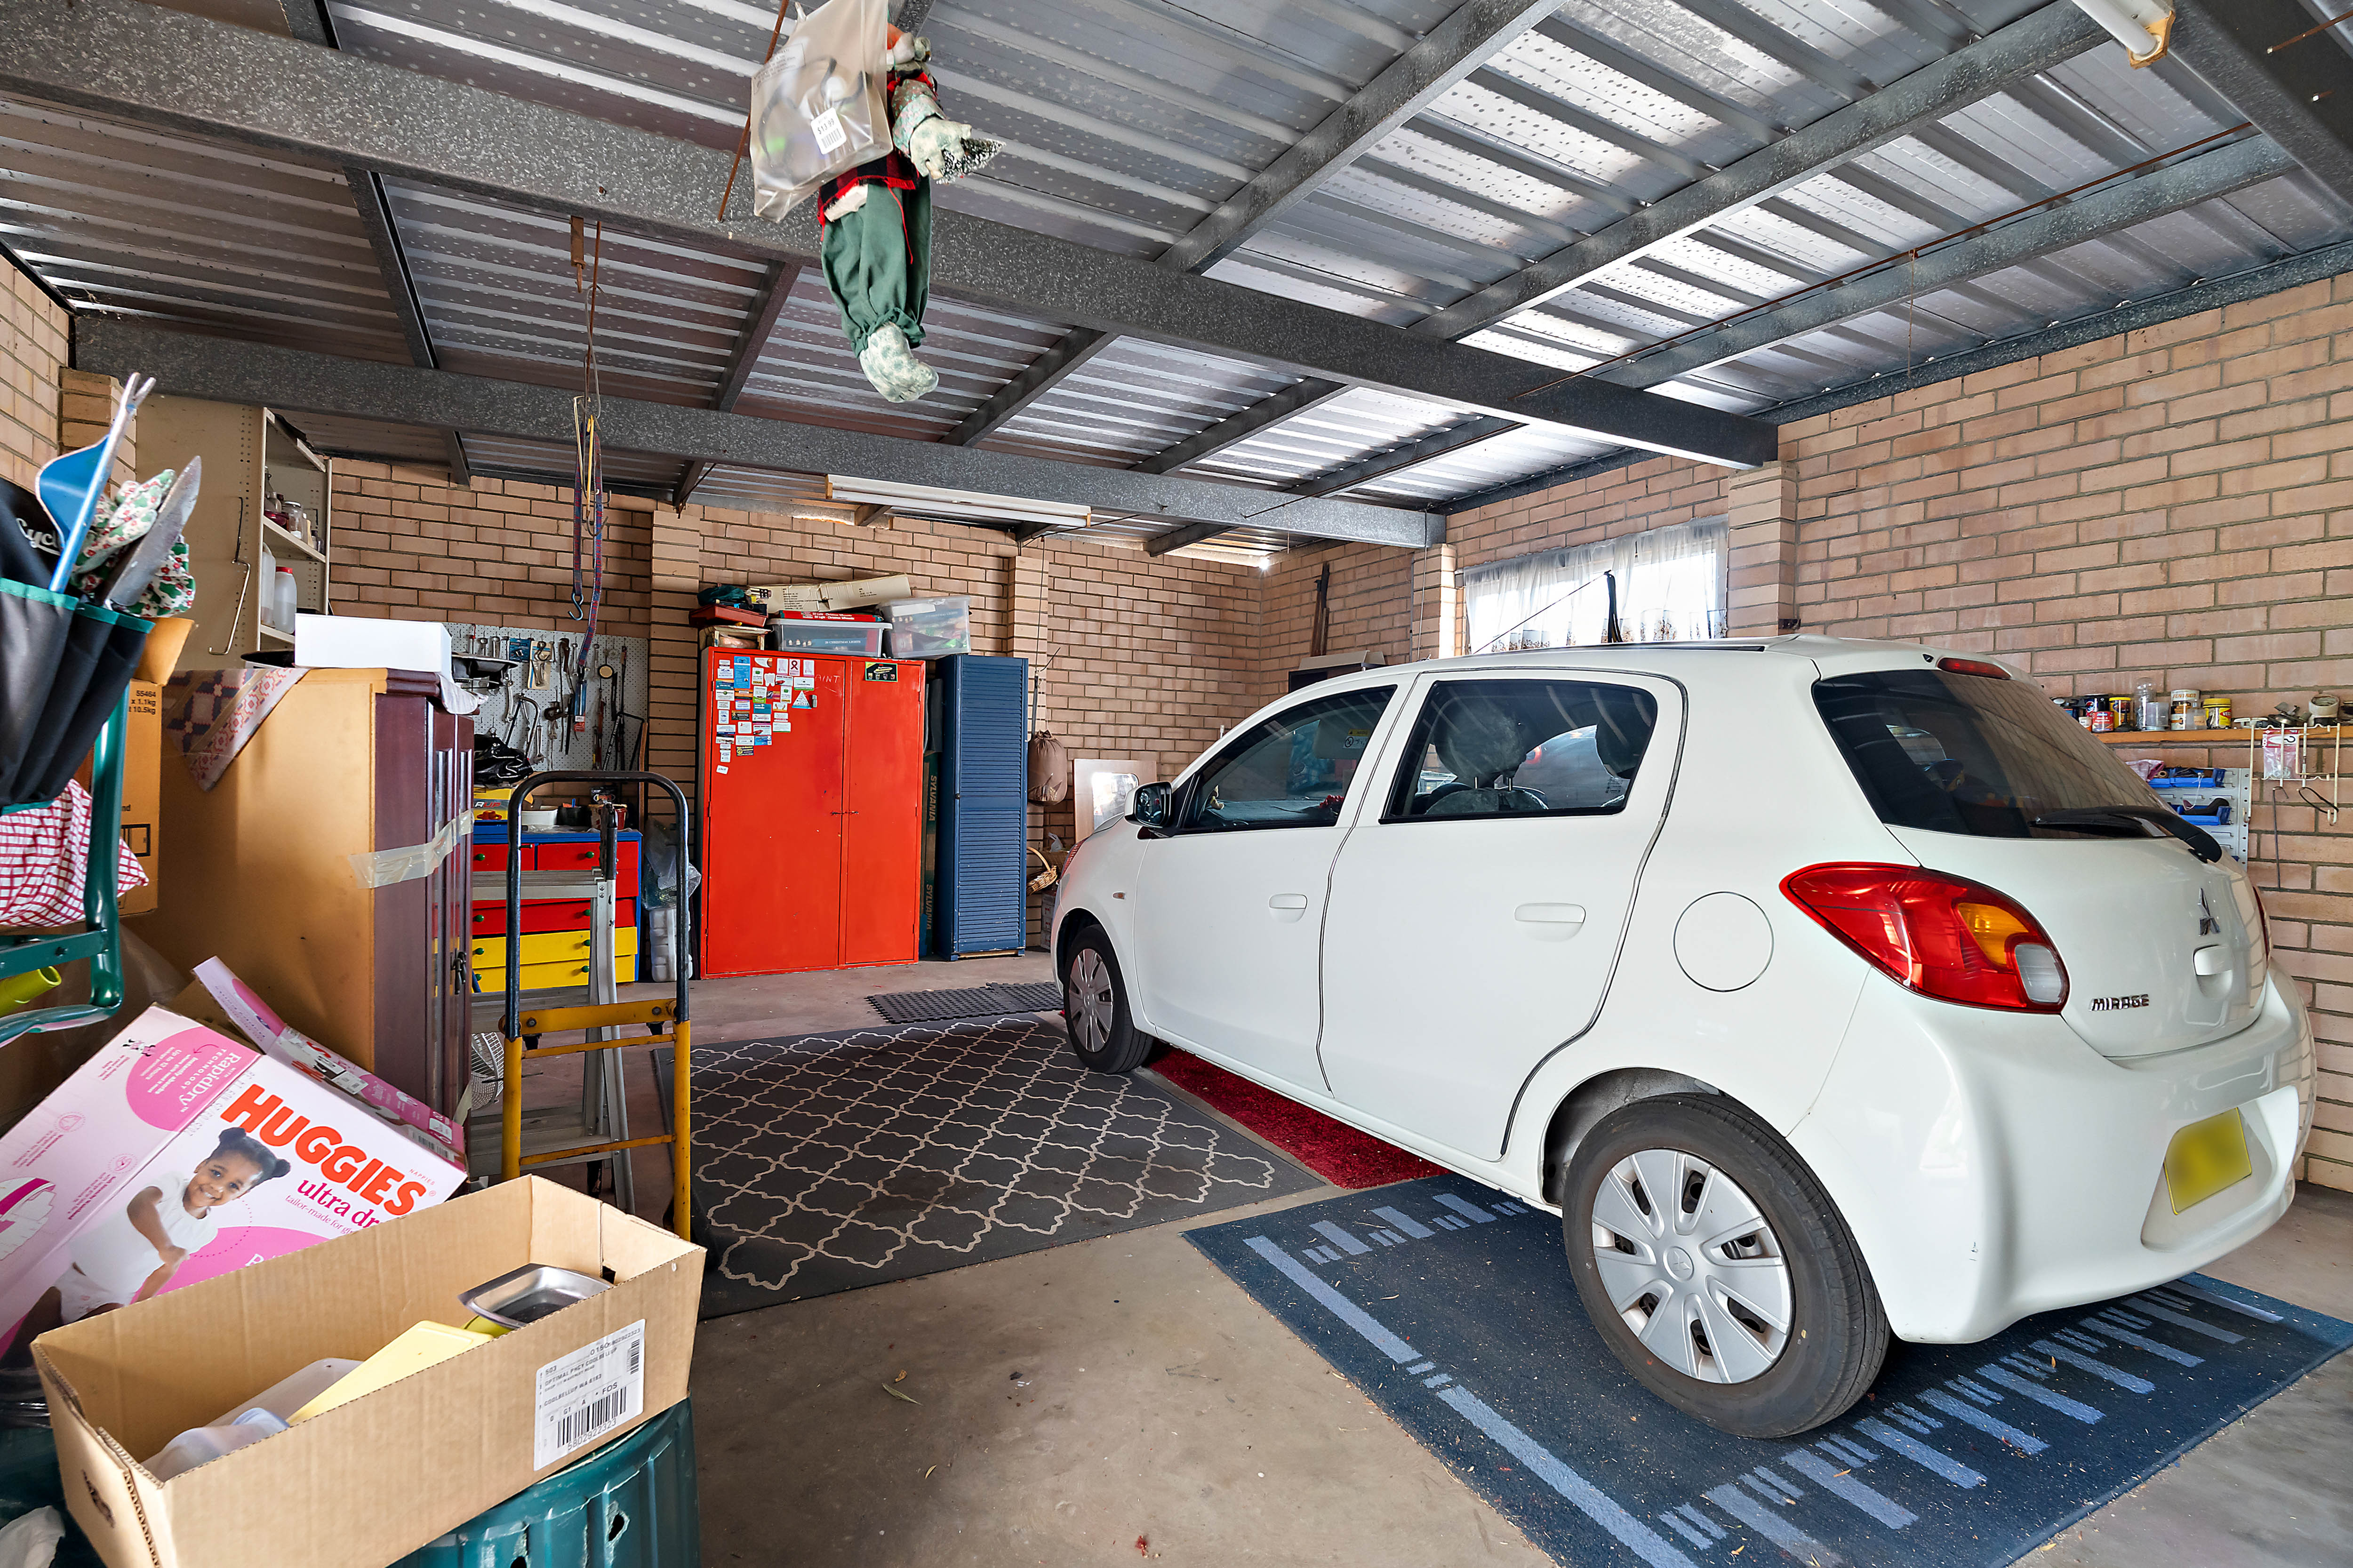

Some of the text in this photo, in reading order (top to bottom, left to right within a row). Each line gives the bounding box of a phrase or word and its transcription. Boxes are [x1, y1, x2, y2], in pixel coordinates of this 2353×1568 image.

[815, 674, 840, 683] AINT
[929, 775, 937, 821] SYLVANIA
[926, 884, 934, 930] SYLVANIA
[2089, 994, 2150, 1012] MIRAGE
[181, 1048, 227, 1089] TECHNOLOGY
[220, 1083, 427, 1216] HUGGIES
[408, 1168, 435, 1185] NAPPIES
[285, 1194, 330, 1224] tailor-made
[329, 1218, 344, 1230] for
[297, 1179, 380, 1229] ultra dr
[544, 1385, 578, 1406] COOLBELLUP
[579, 1380, 588, 1388] WA
[545, 1372, 569, 1386] OPTIMAL
[602, 1382, 618, 1395] FOS
[568, 1418, 616, 1451] 5802922323
